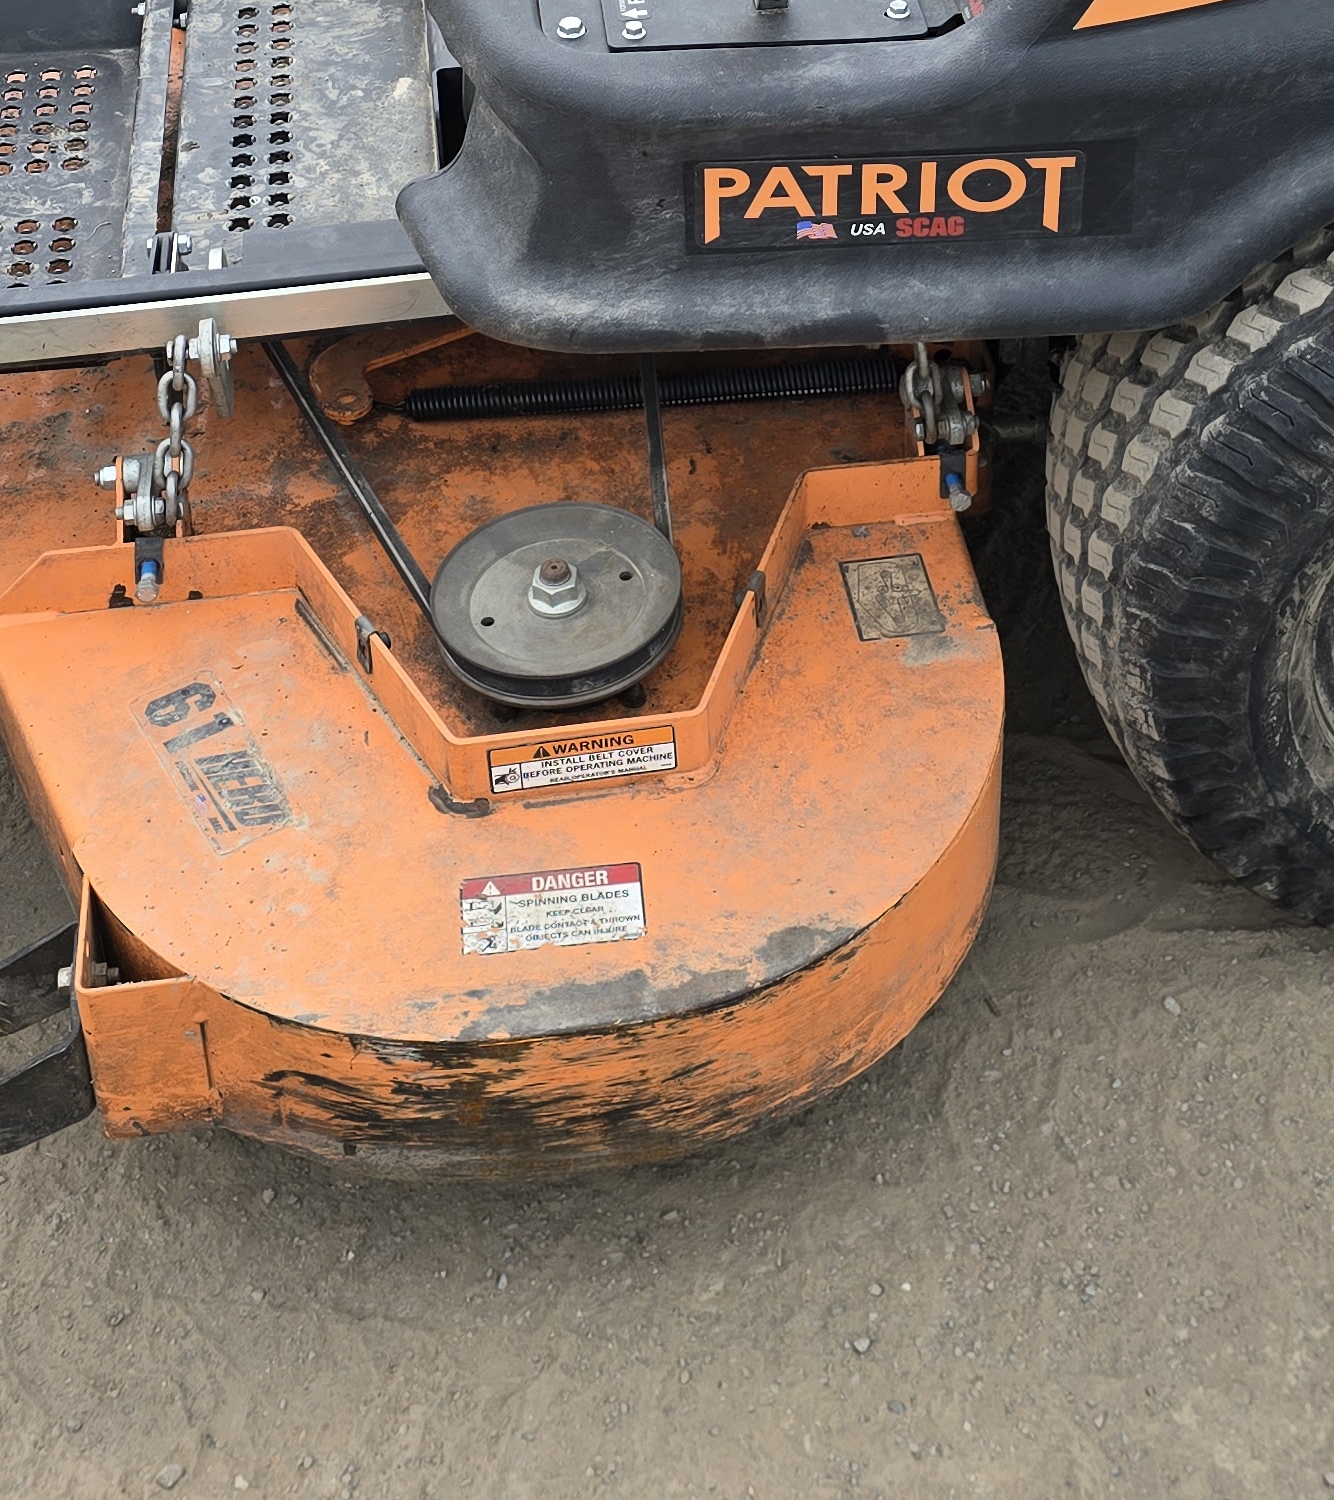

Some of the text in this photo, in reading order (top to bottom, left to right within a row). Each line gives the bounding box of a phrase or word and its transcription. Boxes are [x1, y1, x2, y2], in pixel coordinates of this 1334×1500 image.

[703, 156, 1077, 245] PATRIOT
[849, 216, 965, 239] USA SCAG
[144, 681, 235, 755] 61
[552, 734, 635, 756] WARNING
[523, 751, 674, 780] BEFORE OPERATING MACHINE
[540, 746, 655, 769] INSTALL BELT COVER
[531, 870, 609, 892] DANGER
[517, 889, 630, 908] SPINNING BLADES
[546, 906, 605, 918] KEEP CLEAR
[509, 923, 542, 935] BLADE
[543, 919, 588, 931] CONTACT
[598, 914, 641, 926] THROWN
[525, 926, 628, 942] OBJECTS CAN INJURE
